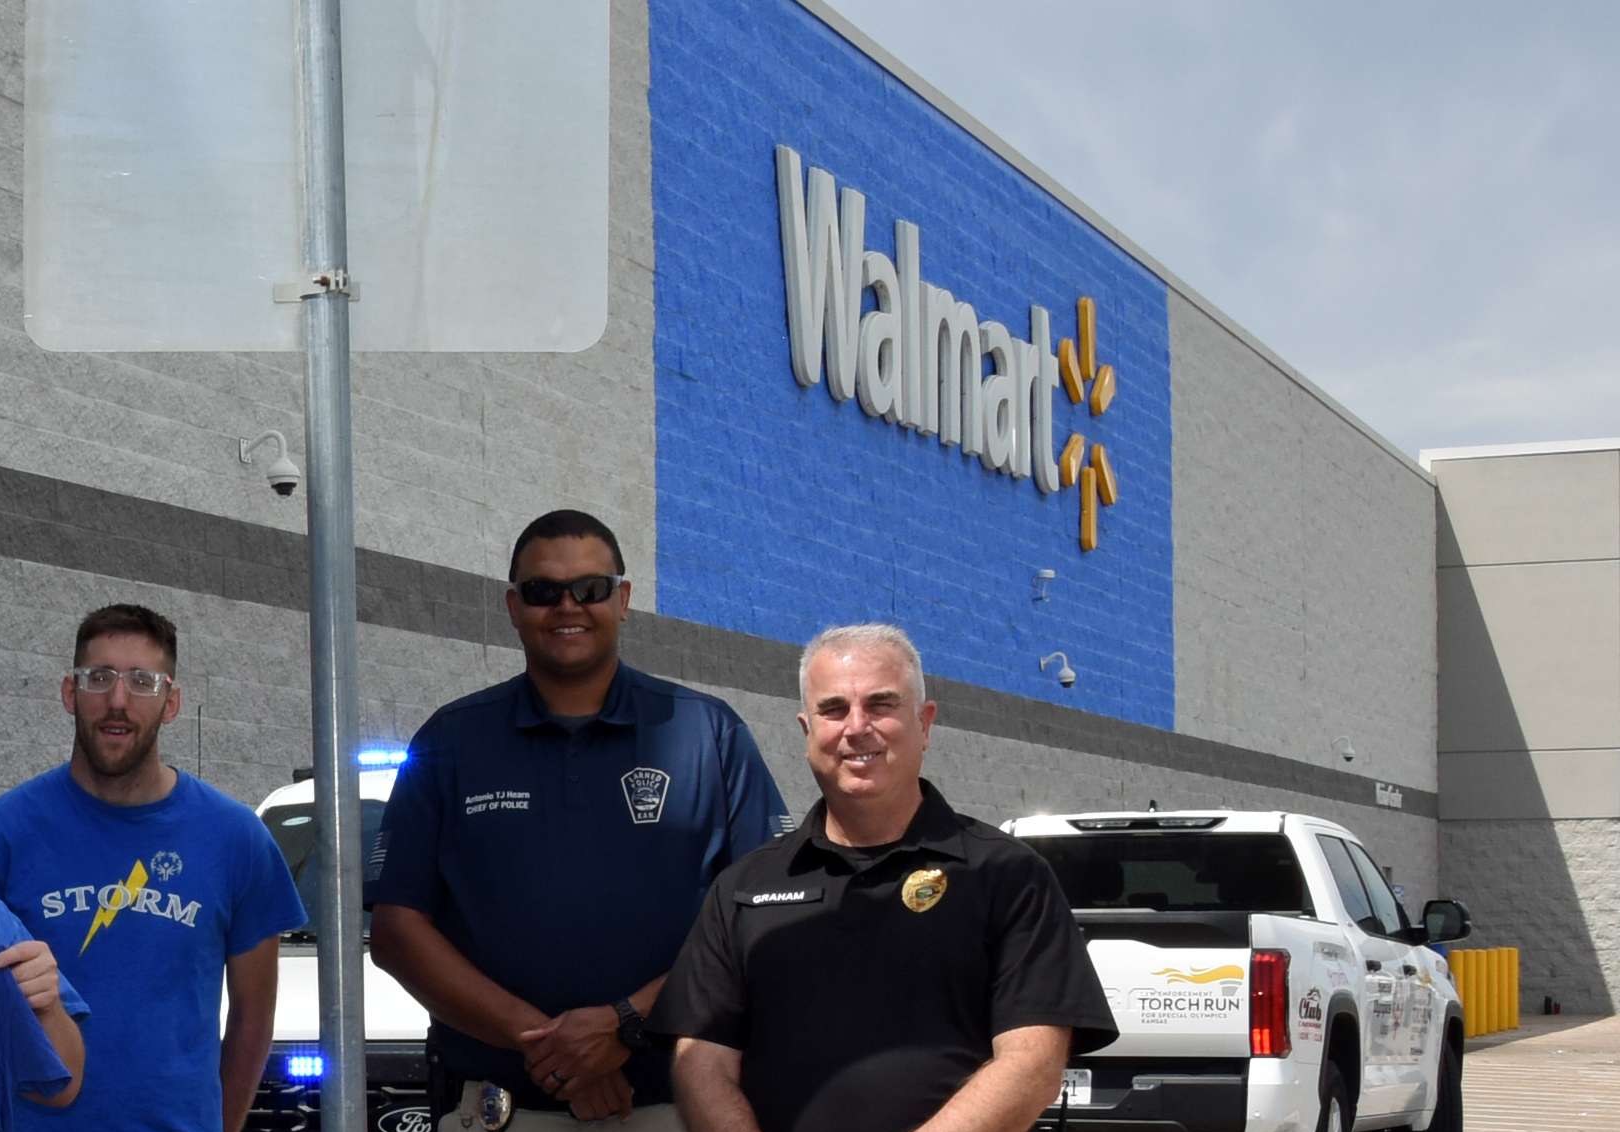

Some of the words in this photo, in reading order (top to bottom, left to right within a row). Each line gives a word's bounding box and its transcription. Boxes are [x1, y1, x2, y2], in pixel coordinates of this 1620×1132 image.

[776, 144, 1060, 495] Walmart
[489, 801, 500, 810] OF
[501, 800, 529, 809] POLICE
[752, 891, 805, 905] GRAHAM
[41, 883, 202, 928] STORM
[1137, 998, 1200, 1011] TORCH
[1204, 998, 1240, 1011] RUN
